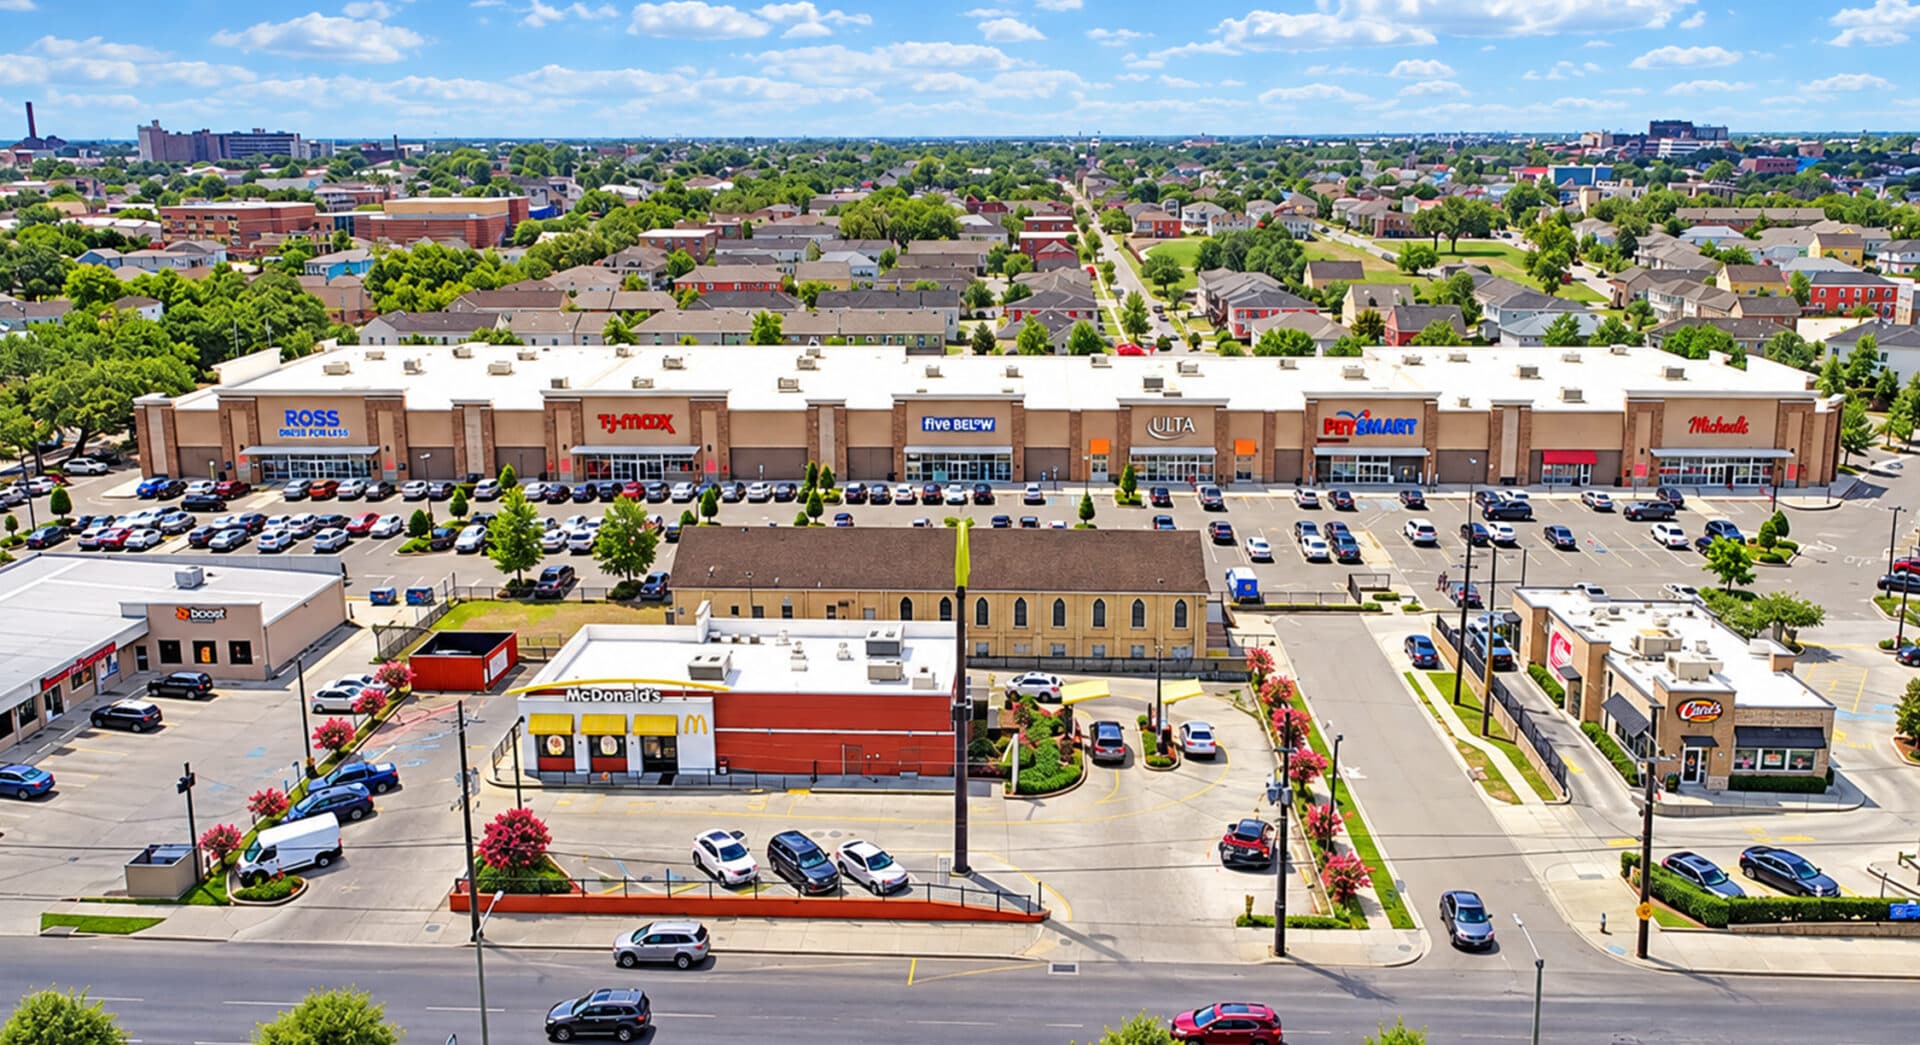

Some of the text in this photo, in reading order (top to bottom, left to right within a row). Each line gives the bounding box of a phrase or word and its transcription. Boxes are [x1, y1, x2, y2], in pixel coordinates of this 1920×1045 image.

[284, 409, 340, 428] ROSS
[924, 417, 994, 431] five BELOW
[1152, 416, 1196, 433] ULTA
[1688, 415, 1750, 435] Michaels
[190, 608, 226, 620] boost
[566, 687, 662, 703] McDonald's
[1680, 700, 1722, 720] Cane's
